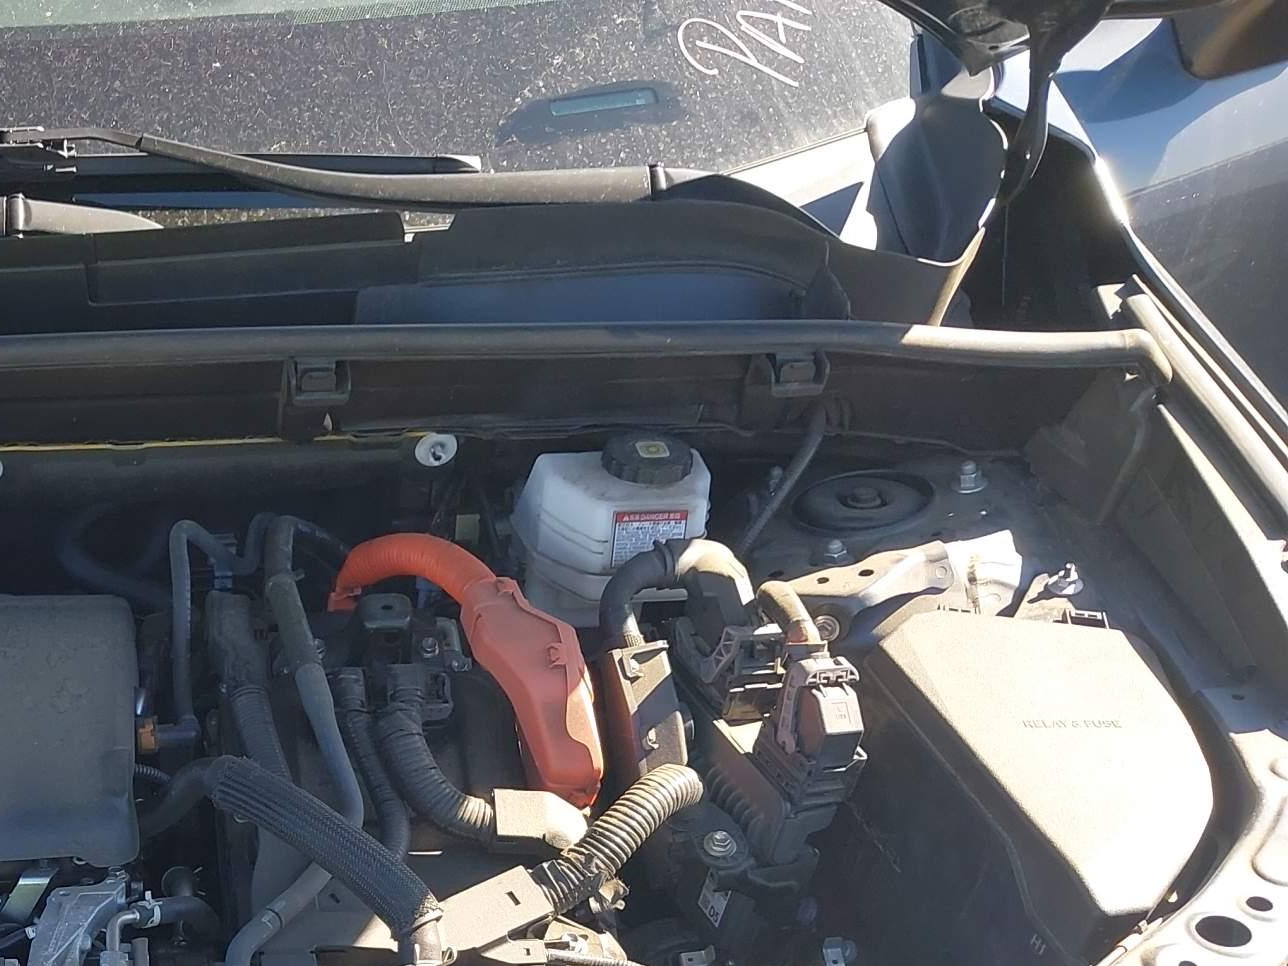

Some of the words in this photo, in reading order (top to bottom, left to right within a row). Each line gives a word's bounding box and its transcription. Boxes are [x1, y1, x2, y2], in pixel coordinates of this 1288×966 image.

[1022, 719, 1068, 729] RELAY
[1083, 719, 1123, 729] FUSE
[1030, 932, 1047, 956] H1
